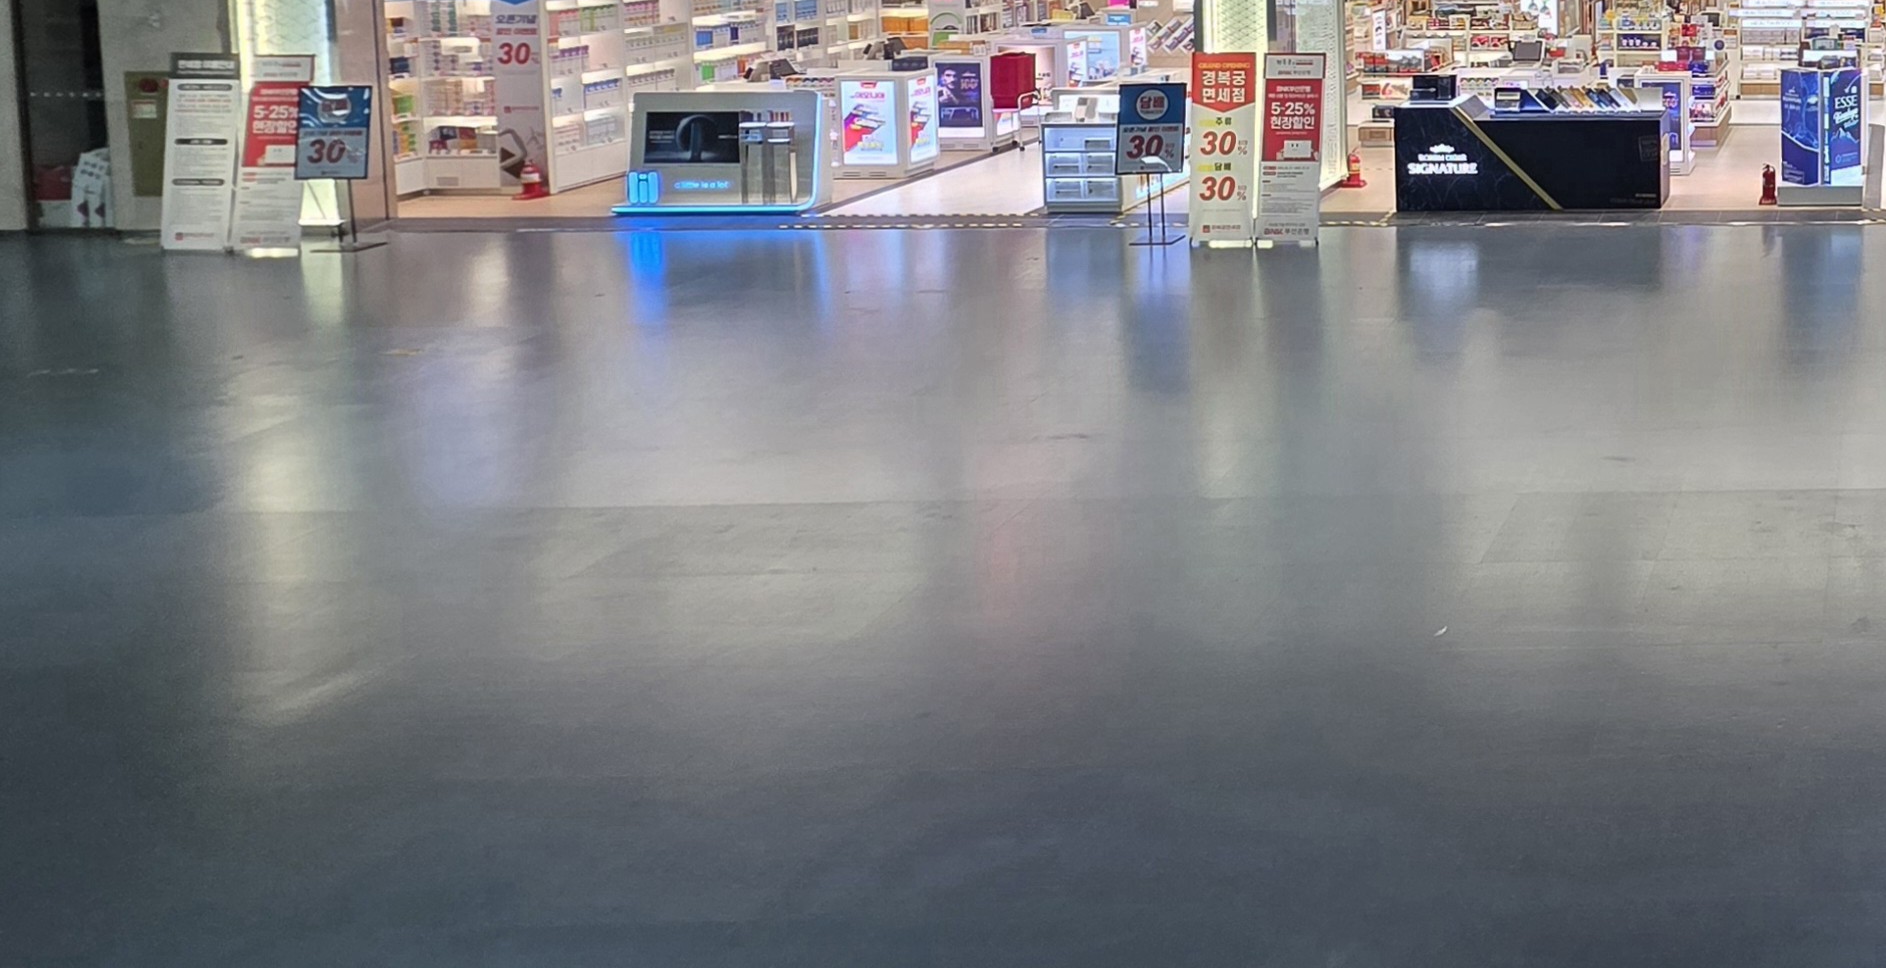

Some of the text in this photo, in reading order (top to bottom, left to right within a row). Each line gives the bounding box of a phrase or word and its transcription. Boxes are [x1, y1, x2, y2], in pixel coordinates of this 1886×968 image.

[497, 42, 531, 65] 30
[1202, 71, 1246, 86] 경복궁
[1202, 88, 1246, 103] 면세점
[1834, 95, 1858, 109] ESSE
[1270, 116, 1315, 130] 현장할인
[307, 139, 346, 164] 30
[1126, 135, 1164, 159] 30
[1200, 131, 1237, 156] 30
[1407, 162, 1478, 174] SIGNATURE
[1199, 176, 1236, 201] 30
